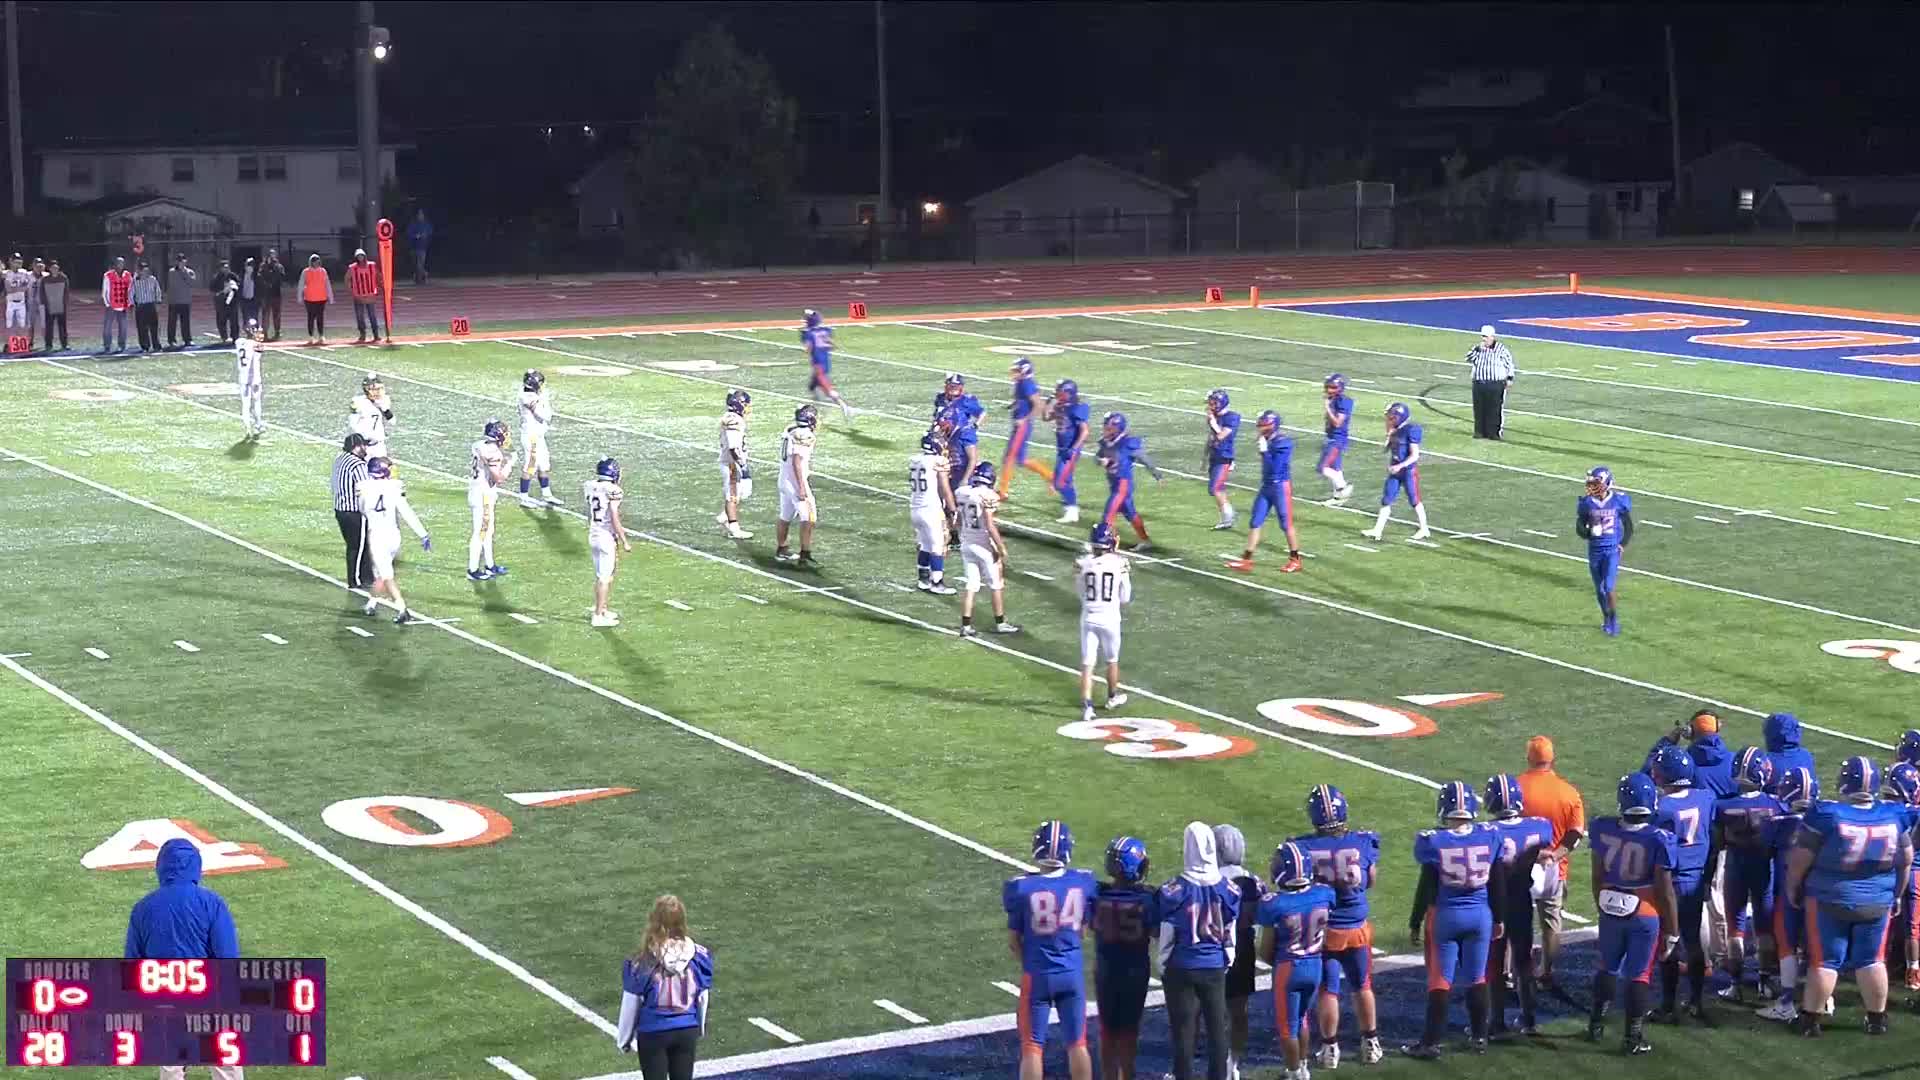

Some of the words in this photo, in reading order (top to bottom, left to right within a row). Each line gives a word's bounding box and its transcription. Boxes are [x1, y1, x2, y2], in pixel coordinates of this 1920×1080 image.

[853, 304, 866, 317] 10
[453, 319, 469, 333] 20
[11, 337, 27, 352] 30
[239, 347, 247, 367] 2
[371, 414, 380, 430] 7
[373, 494, 387, 513] 4
[1084, 571, 1114, 602] 80
[1678, 807, 1700, 846] 7
[1600, 832, 1648, 881] 70
[1838, 822, 1898, 866] 77
[1439, 845, 1491, 888] 55
[1029, 887, 1085, 934] 84
